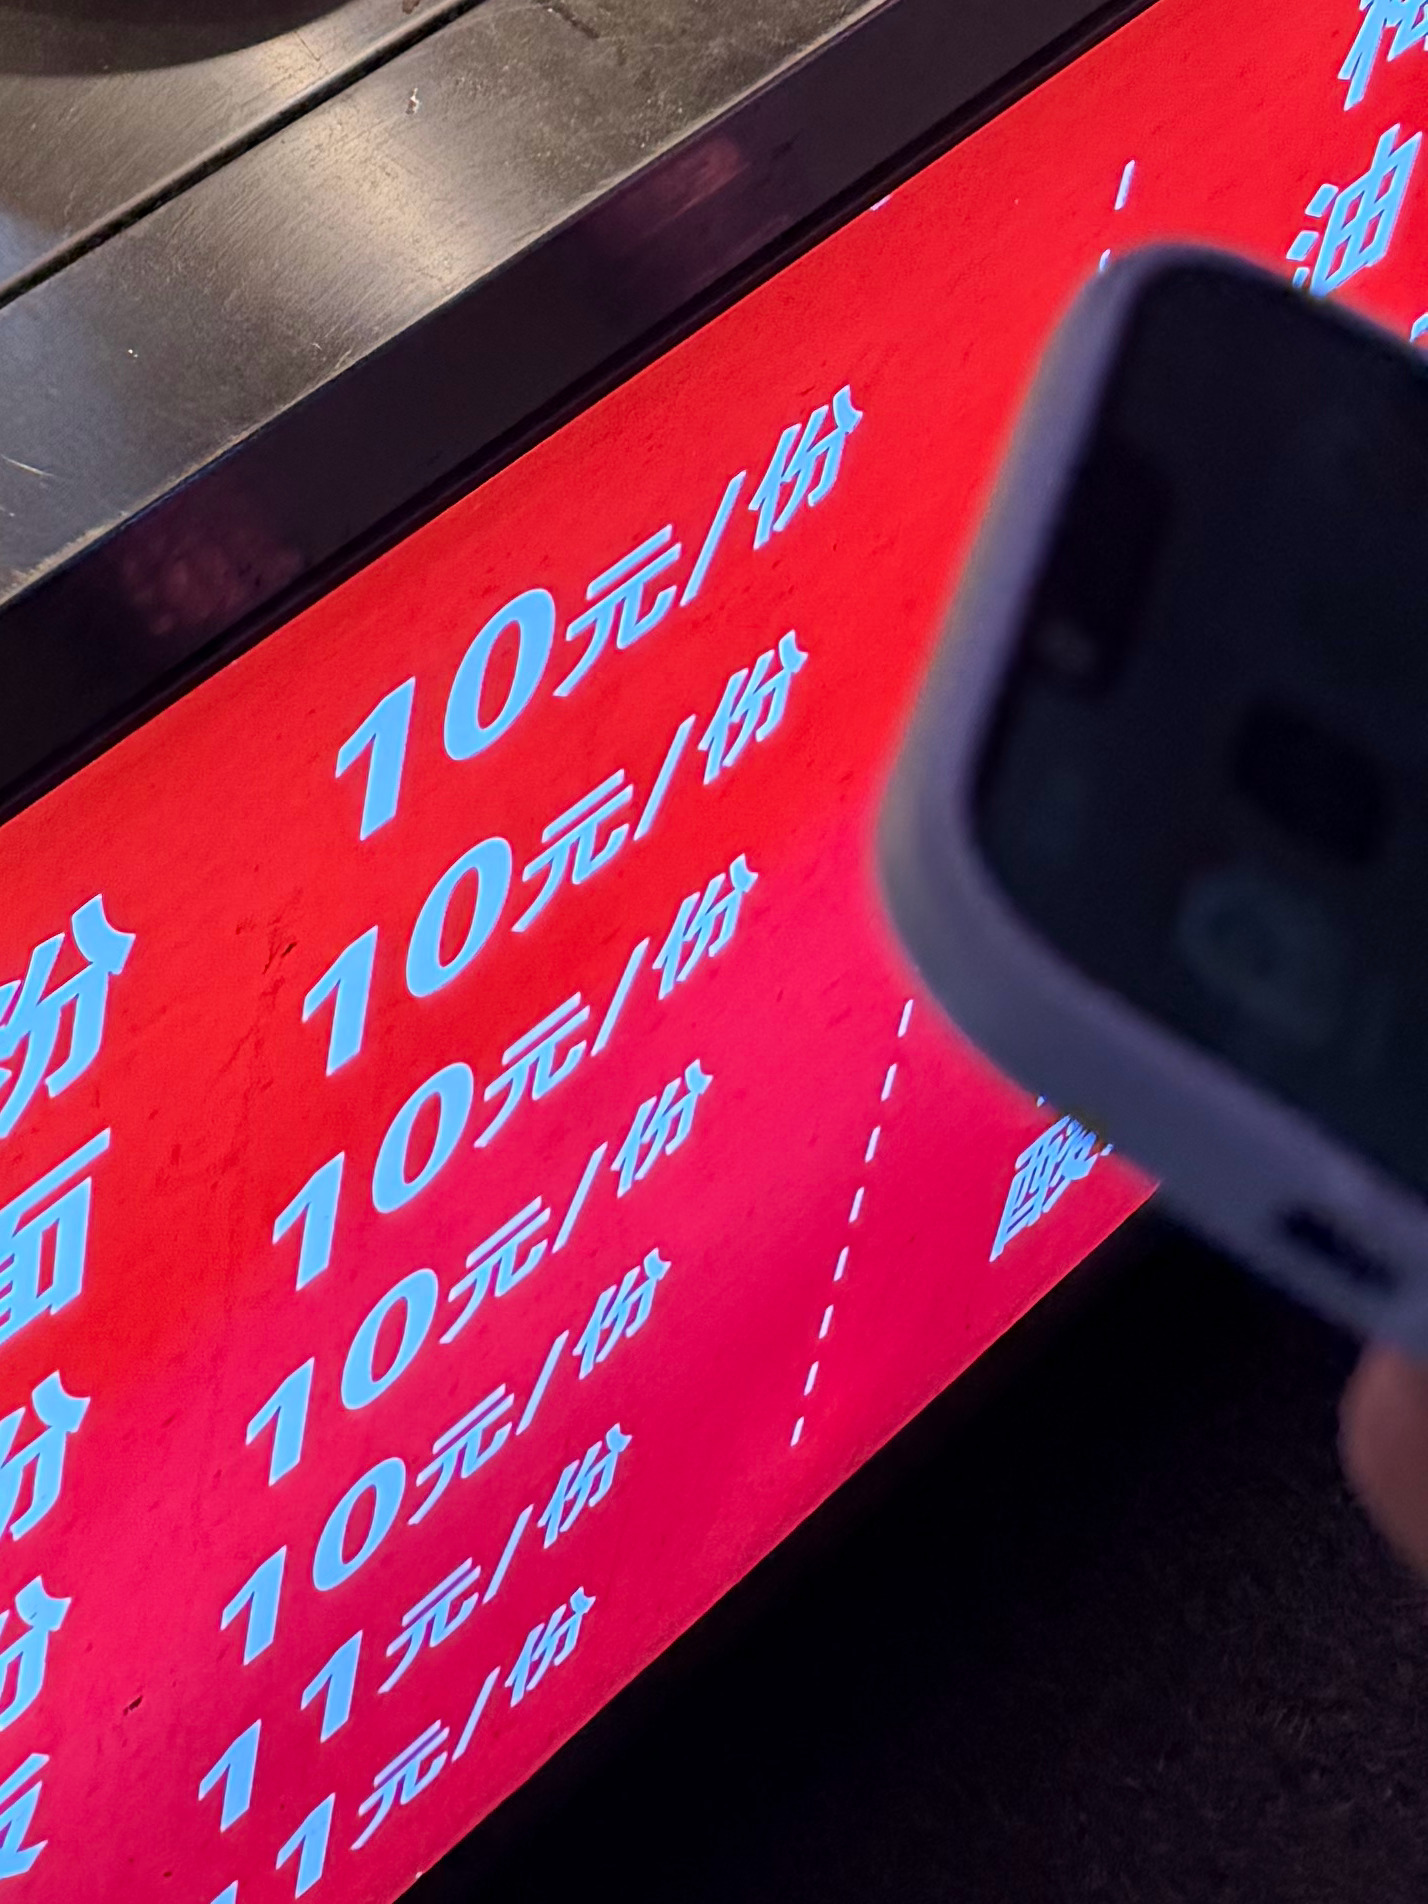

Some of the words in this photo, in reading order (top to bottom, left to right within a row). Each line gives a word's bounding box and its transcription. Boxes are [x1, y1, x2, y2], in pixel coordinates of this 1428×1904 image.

[1286, 123, 1423, 298] 油
[334, 384, 864, 841] 10元/份
[301, 629, 809, 1077] 10元/份
[244, 1058, 714, 1486] 10元/份
[270, 853, 760, 1291] 10元/份
[197, 1423, 632, 1832] 11元/份
[219, 1247, 672, 1665] 10元/份
[206, 1587, 596, 1904] 1元/份
